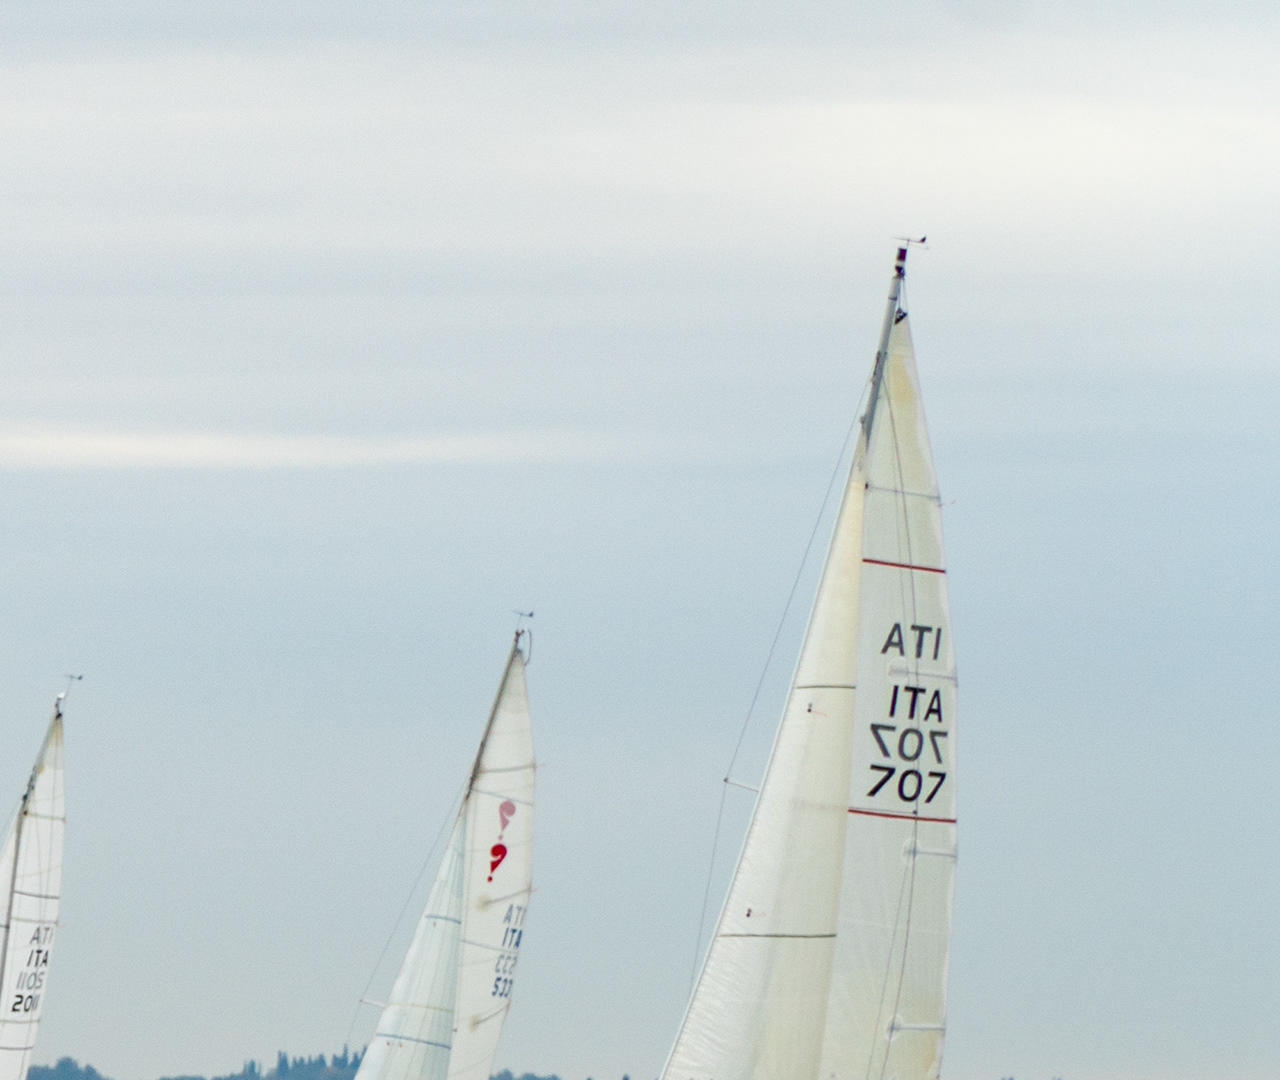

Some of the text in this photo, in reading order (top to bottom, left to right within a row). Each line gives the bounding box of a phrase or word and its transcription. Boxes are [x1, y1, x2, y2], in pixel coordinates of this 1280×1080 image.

[889, 685, 943, 723] ITA
[866, 764, 947, 804] 707
[502, 927, 523, 948] ITA
[26, 949, 49, 967] ITA
